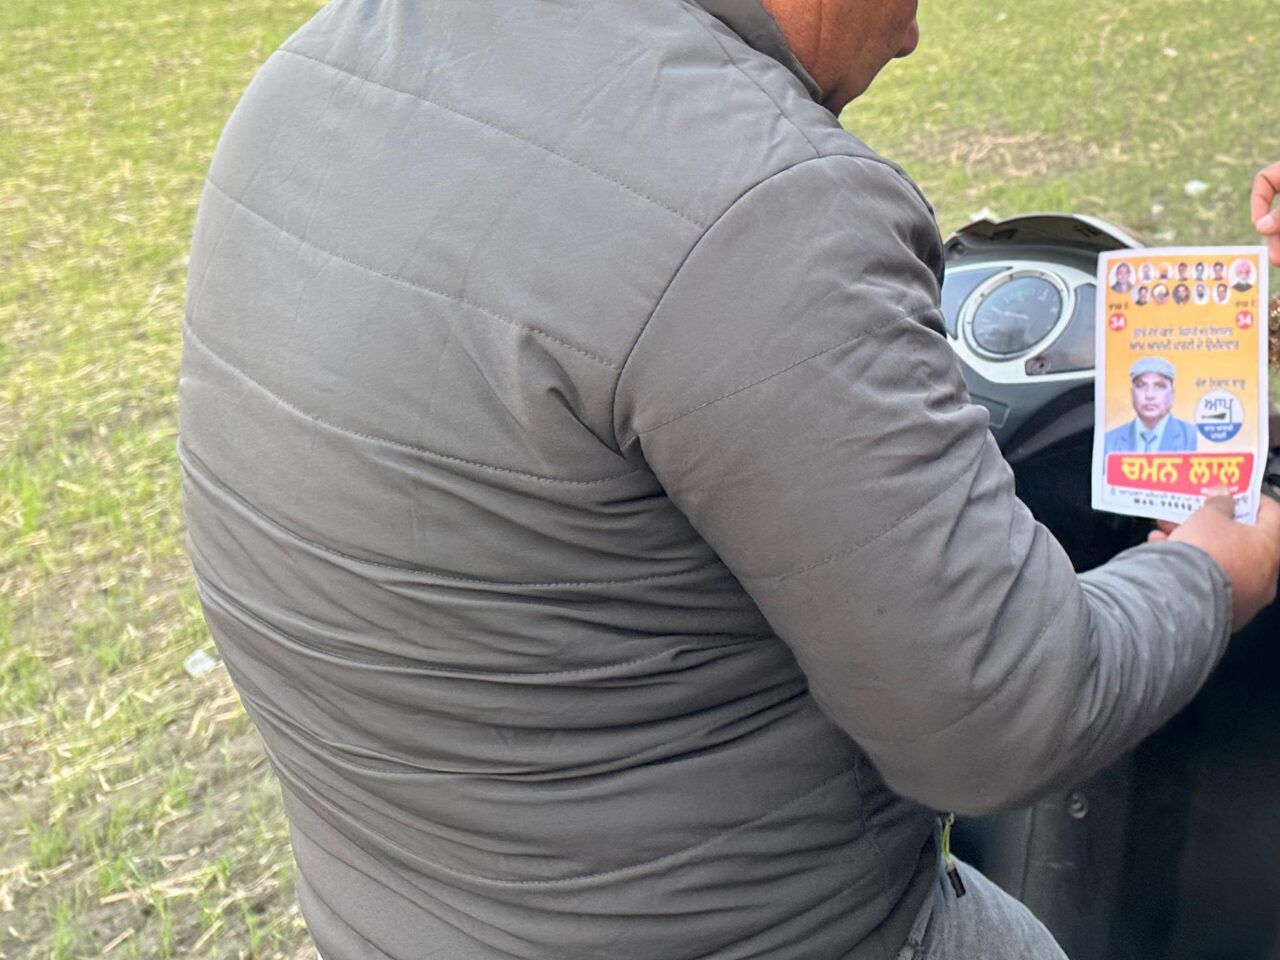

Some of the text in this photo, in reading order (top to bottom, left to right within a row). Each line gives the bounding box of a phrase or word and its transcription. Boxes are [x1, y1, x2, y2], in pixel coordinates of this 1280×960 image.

[1110, 316, 1126, 329] 34
[1236, 314, 1252, 327] 34
[1120, 456, 1244, 484] ਚਮਨ ਲਾਲ
